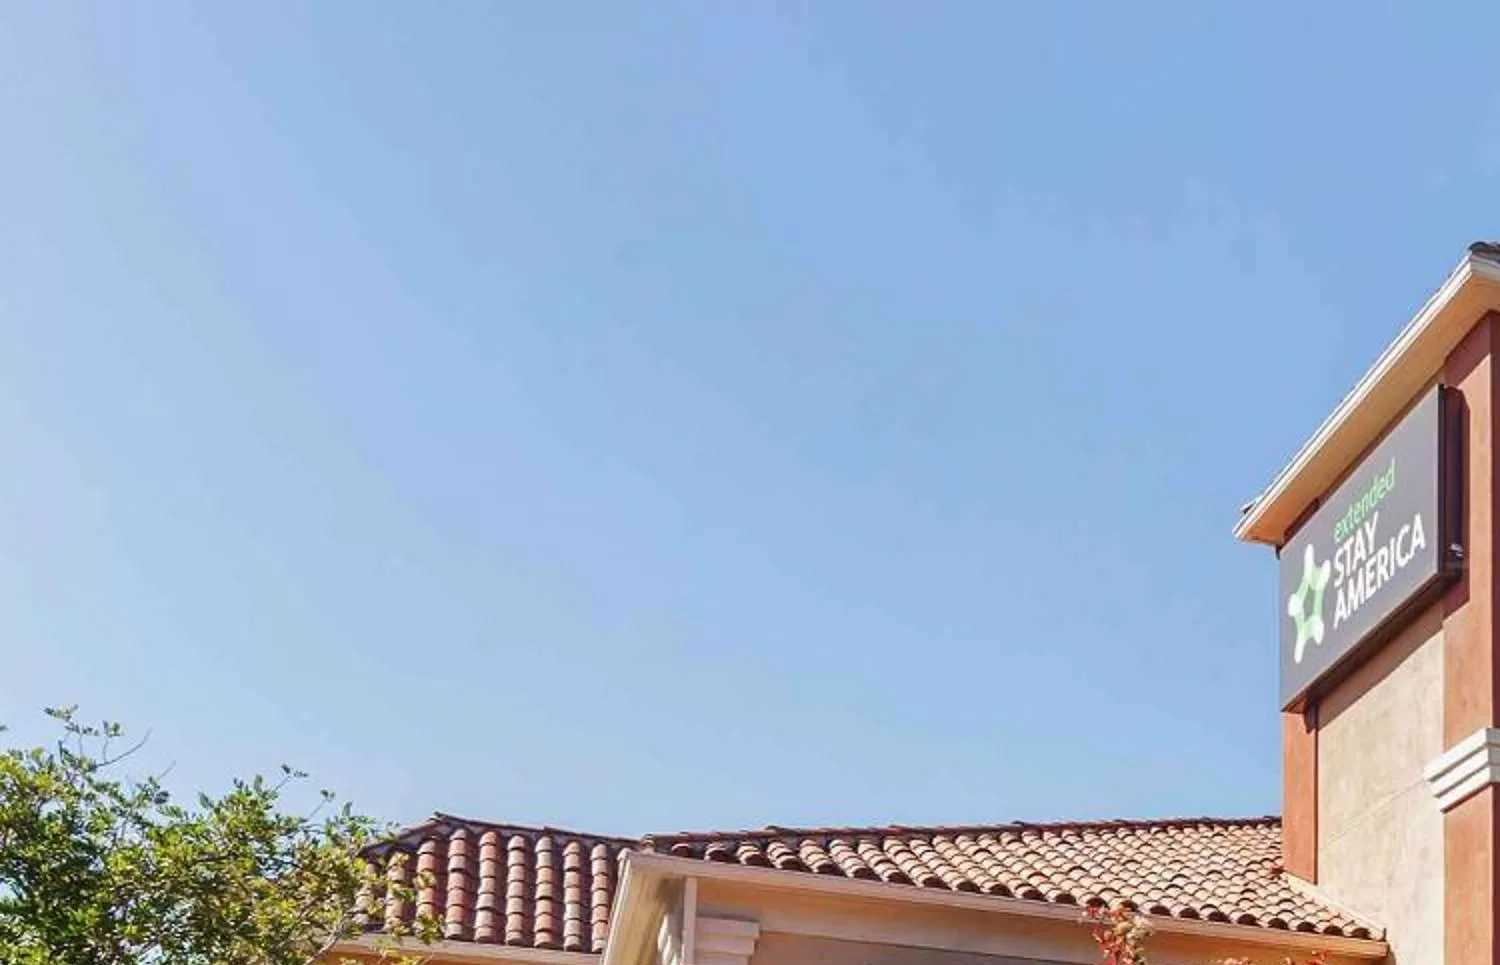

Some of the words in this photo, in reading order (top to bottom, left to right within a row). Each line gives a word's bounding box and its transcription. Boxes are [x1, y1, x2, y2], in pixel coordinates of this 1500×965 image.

[1333, 457, 1396, 544] extended
[1333, 510, 1379, 589] STAY
[1333, 512, 1427, 631] AMERICA
